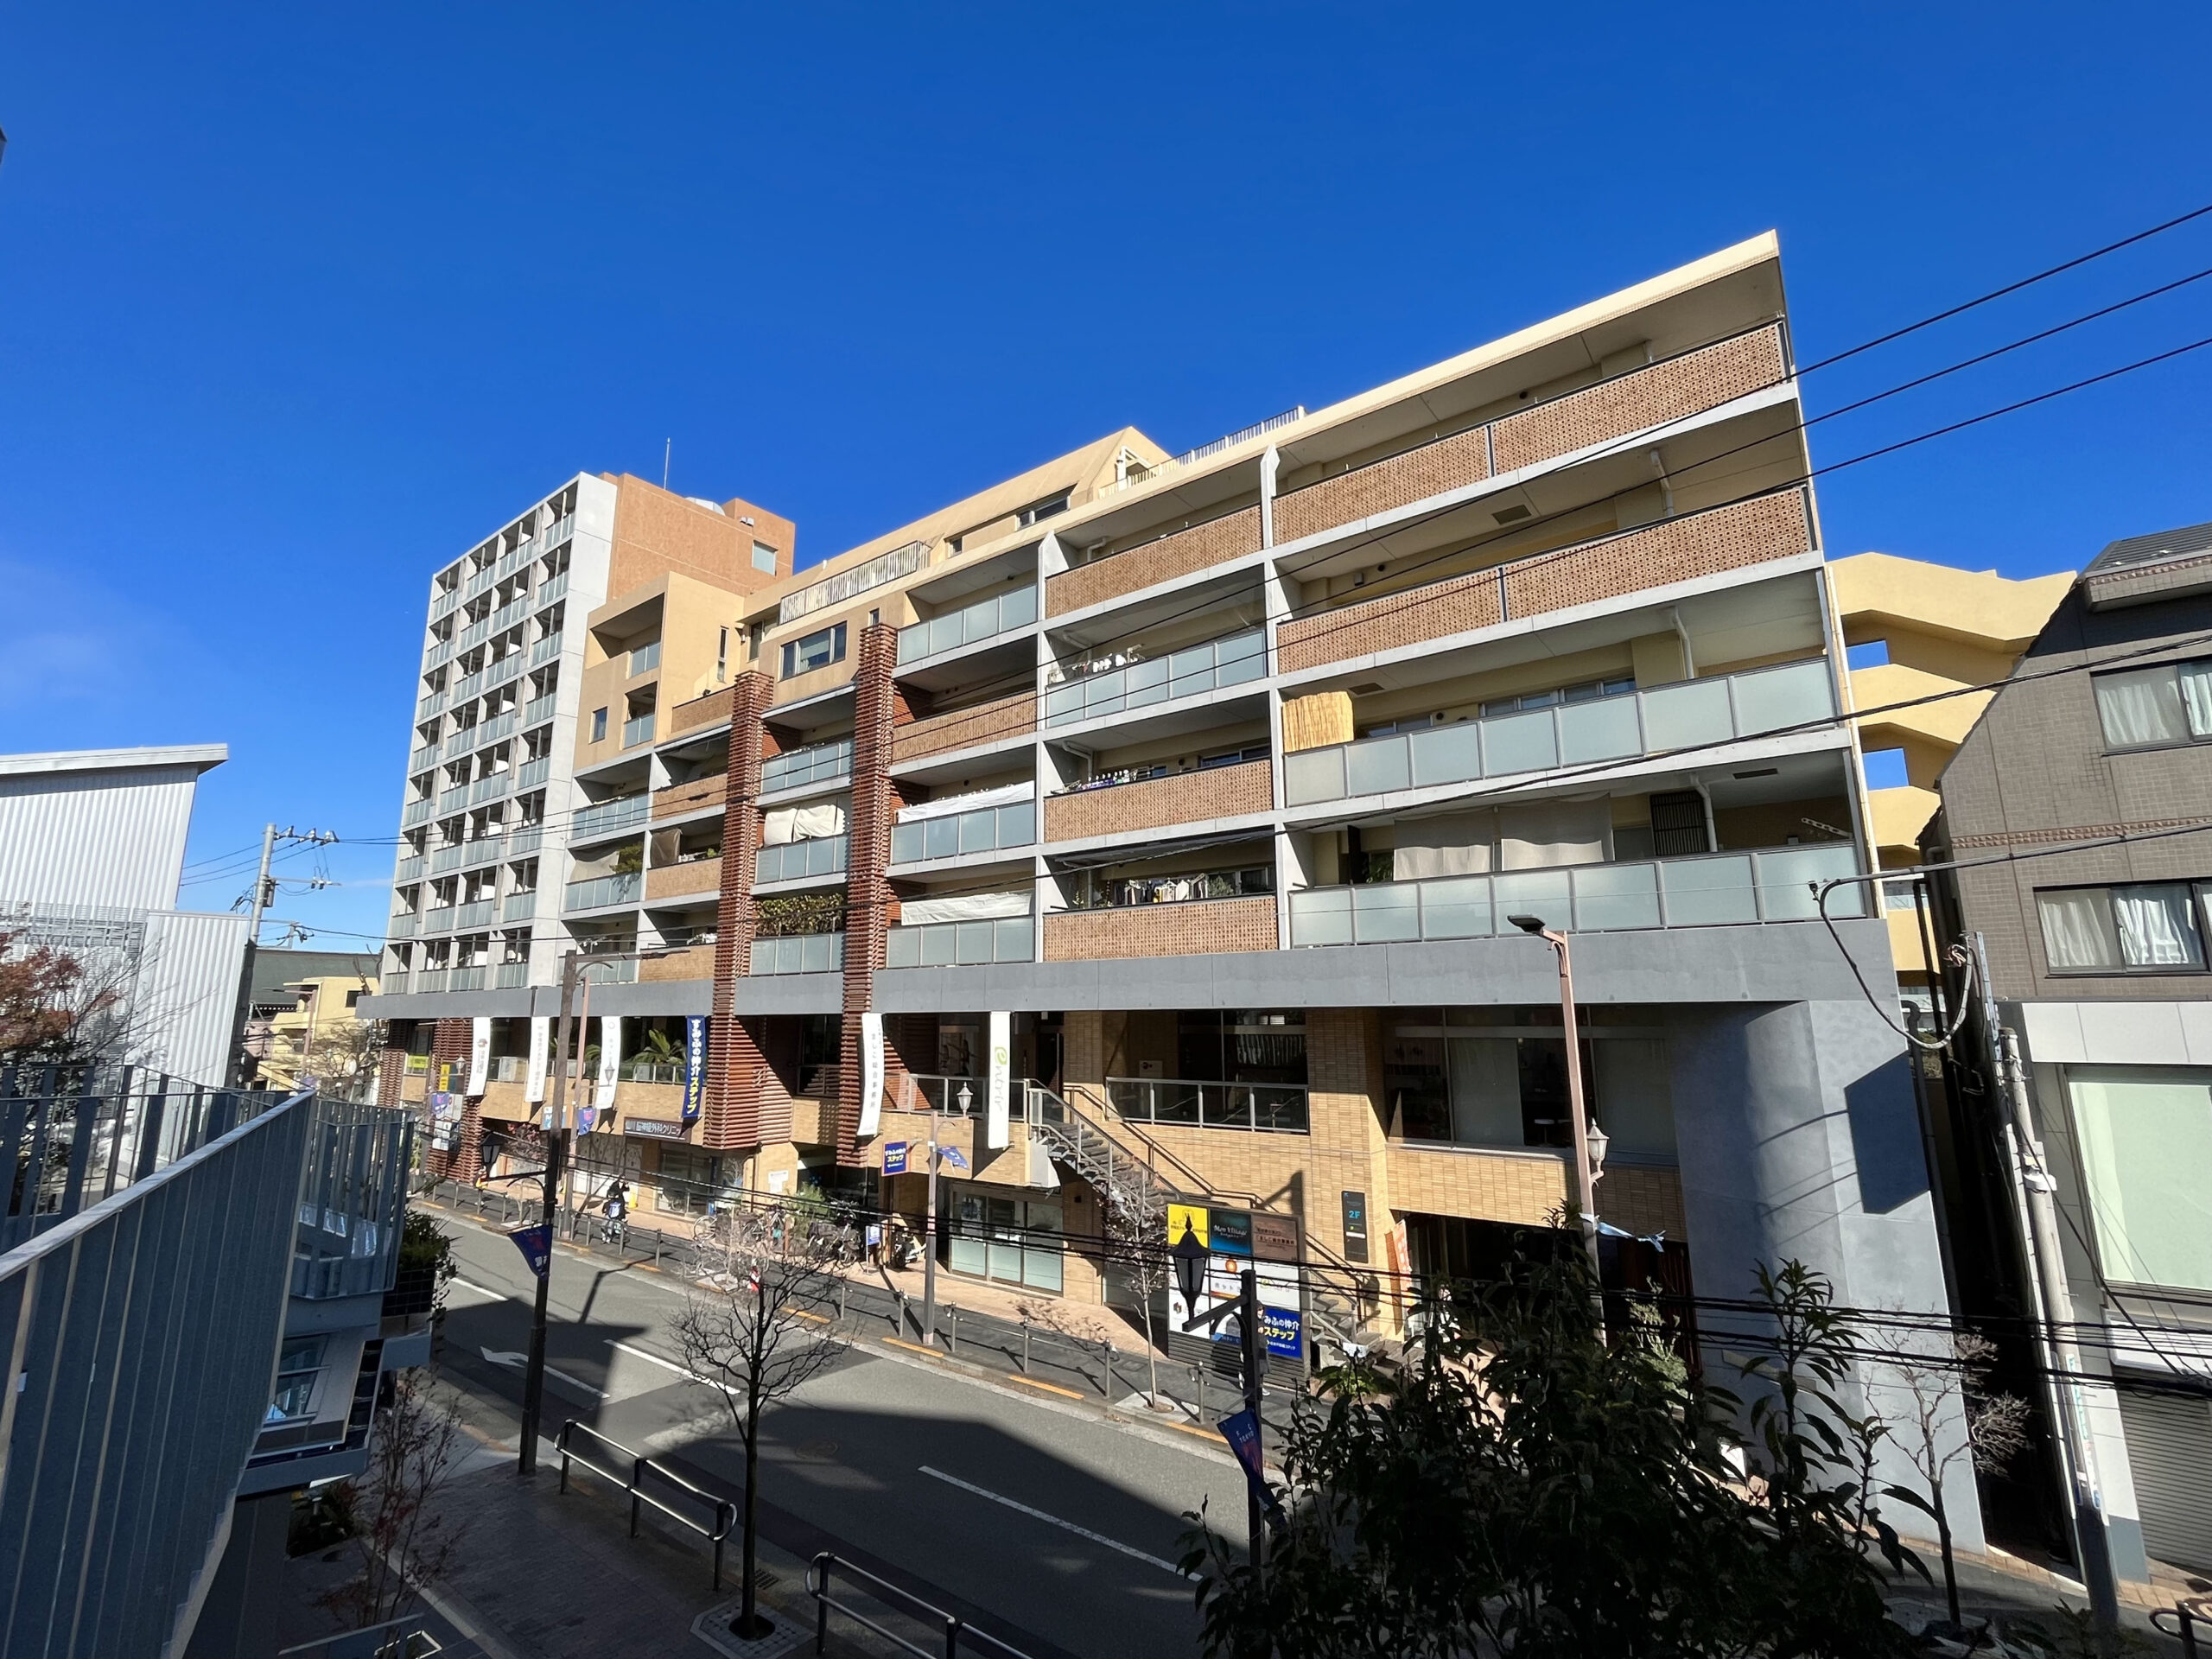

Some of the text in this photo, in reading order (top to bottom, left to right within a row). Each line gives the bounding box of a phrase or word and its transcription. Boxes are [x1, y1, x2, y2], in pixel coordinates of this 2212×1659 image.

[1348, 1210, 1361, 1219] 2F
[1262, 1315, 1300, 1331] みふの仲介
[1264, 1326, 1295, 1341] ステップ
